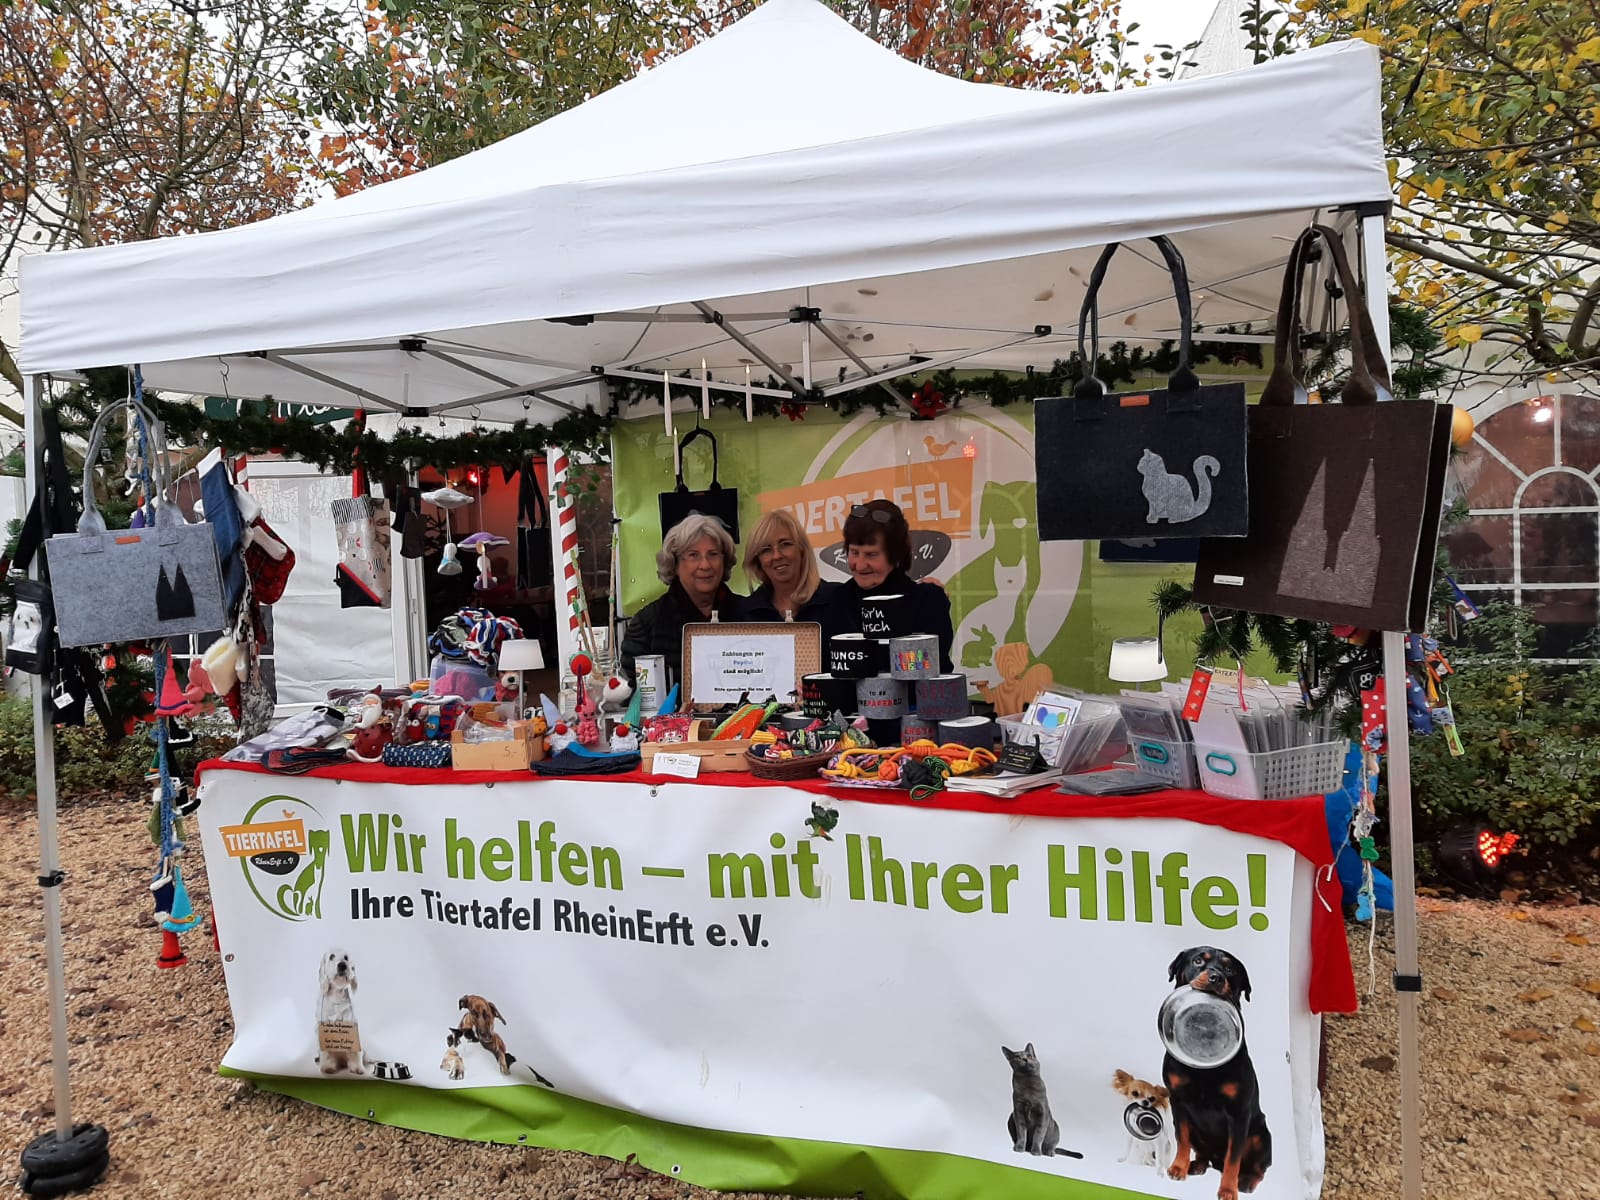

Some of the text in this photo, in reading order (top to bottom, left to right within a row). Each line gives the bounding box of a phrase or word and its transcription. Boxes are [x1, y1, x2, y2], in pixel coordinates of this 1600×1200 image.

[226, 829, 304, 851] TIERTAFEL
[340, 813, 427, 874] Wir
[444, 817, 624, 890] helfen
[707, 832, 822, 899] mit
[845, 833, 1019, 914] Ihrer
[1047, 844, 1269, 931] Hilfe!
[350, 887, 769, 947] Ihre Tiertafel RheinErft e.V.
